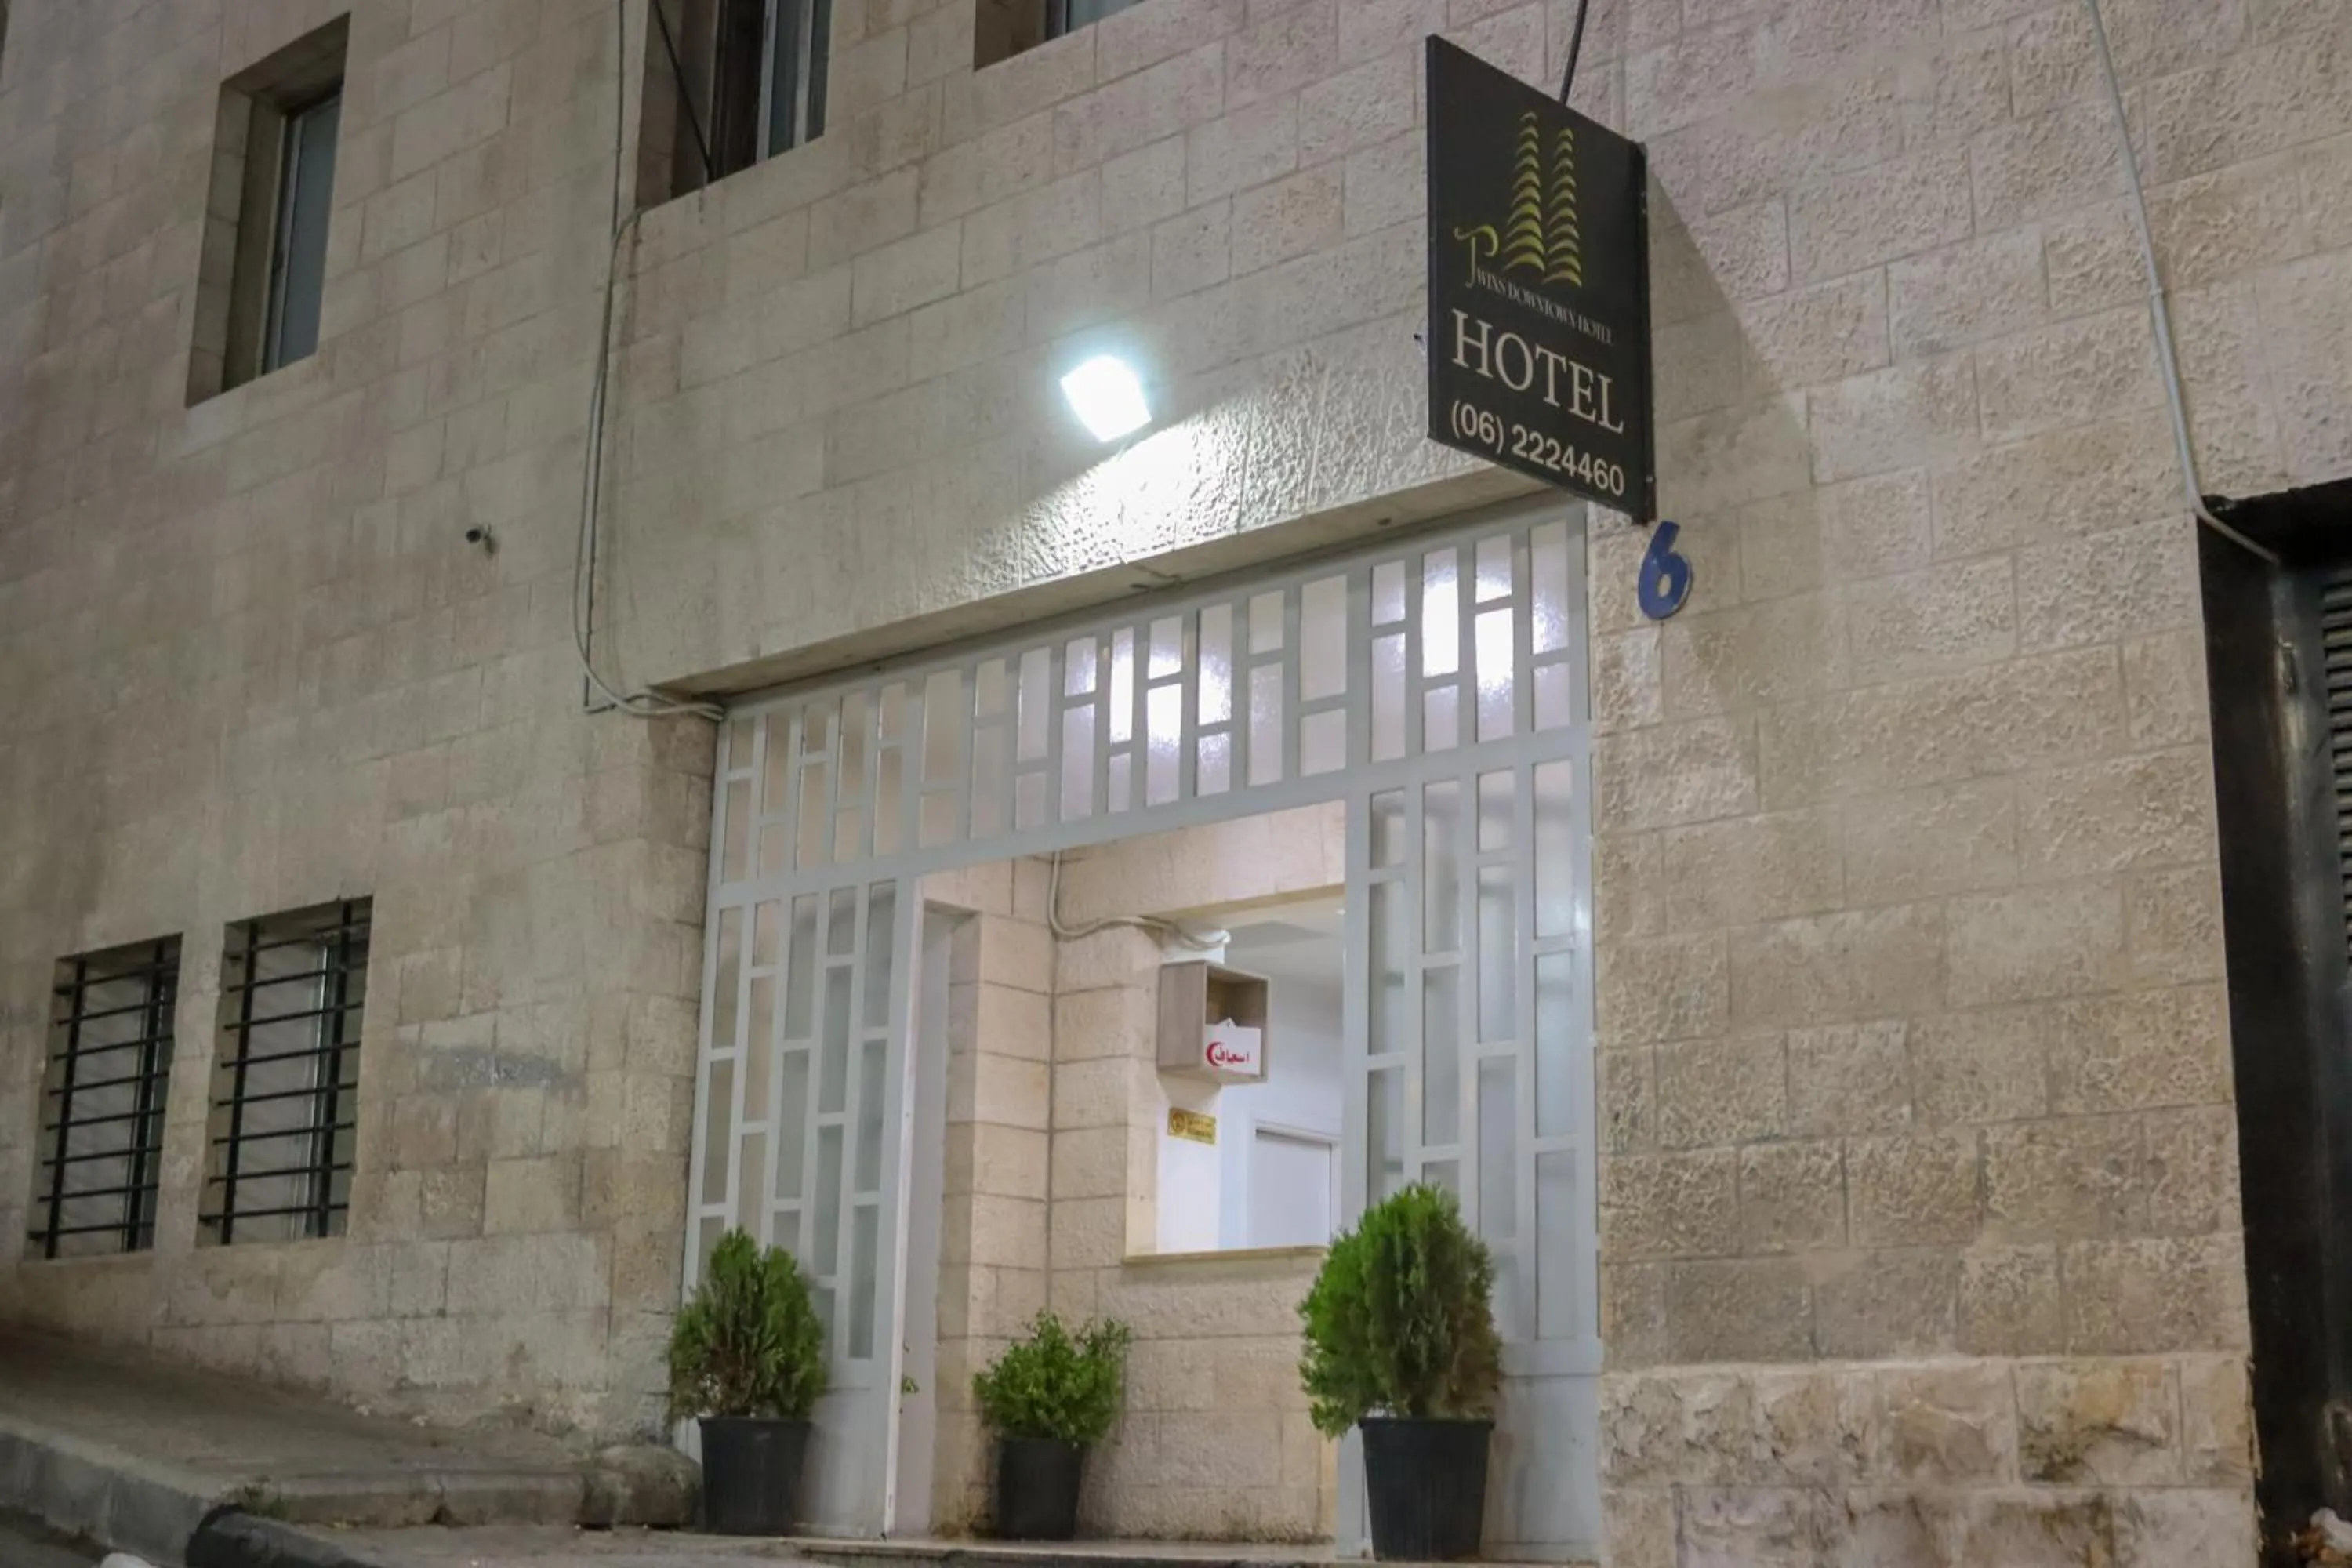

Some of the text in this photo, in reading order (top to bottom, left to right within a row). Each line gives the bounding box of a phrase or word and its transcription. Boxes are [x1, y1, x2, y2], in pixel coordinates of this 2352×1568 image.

[1507, 281, 1577, 328] DOWNTOWN
[1577, 314, 1614, 346] HOTEL
[1451, 308, 1624, 434] HOTEL
[1452, 400, 1625, 496] (06) 2224460
[1638, 520, 1692, 621] 6
